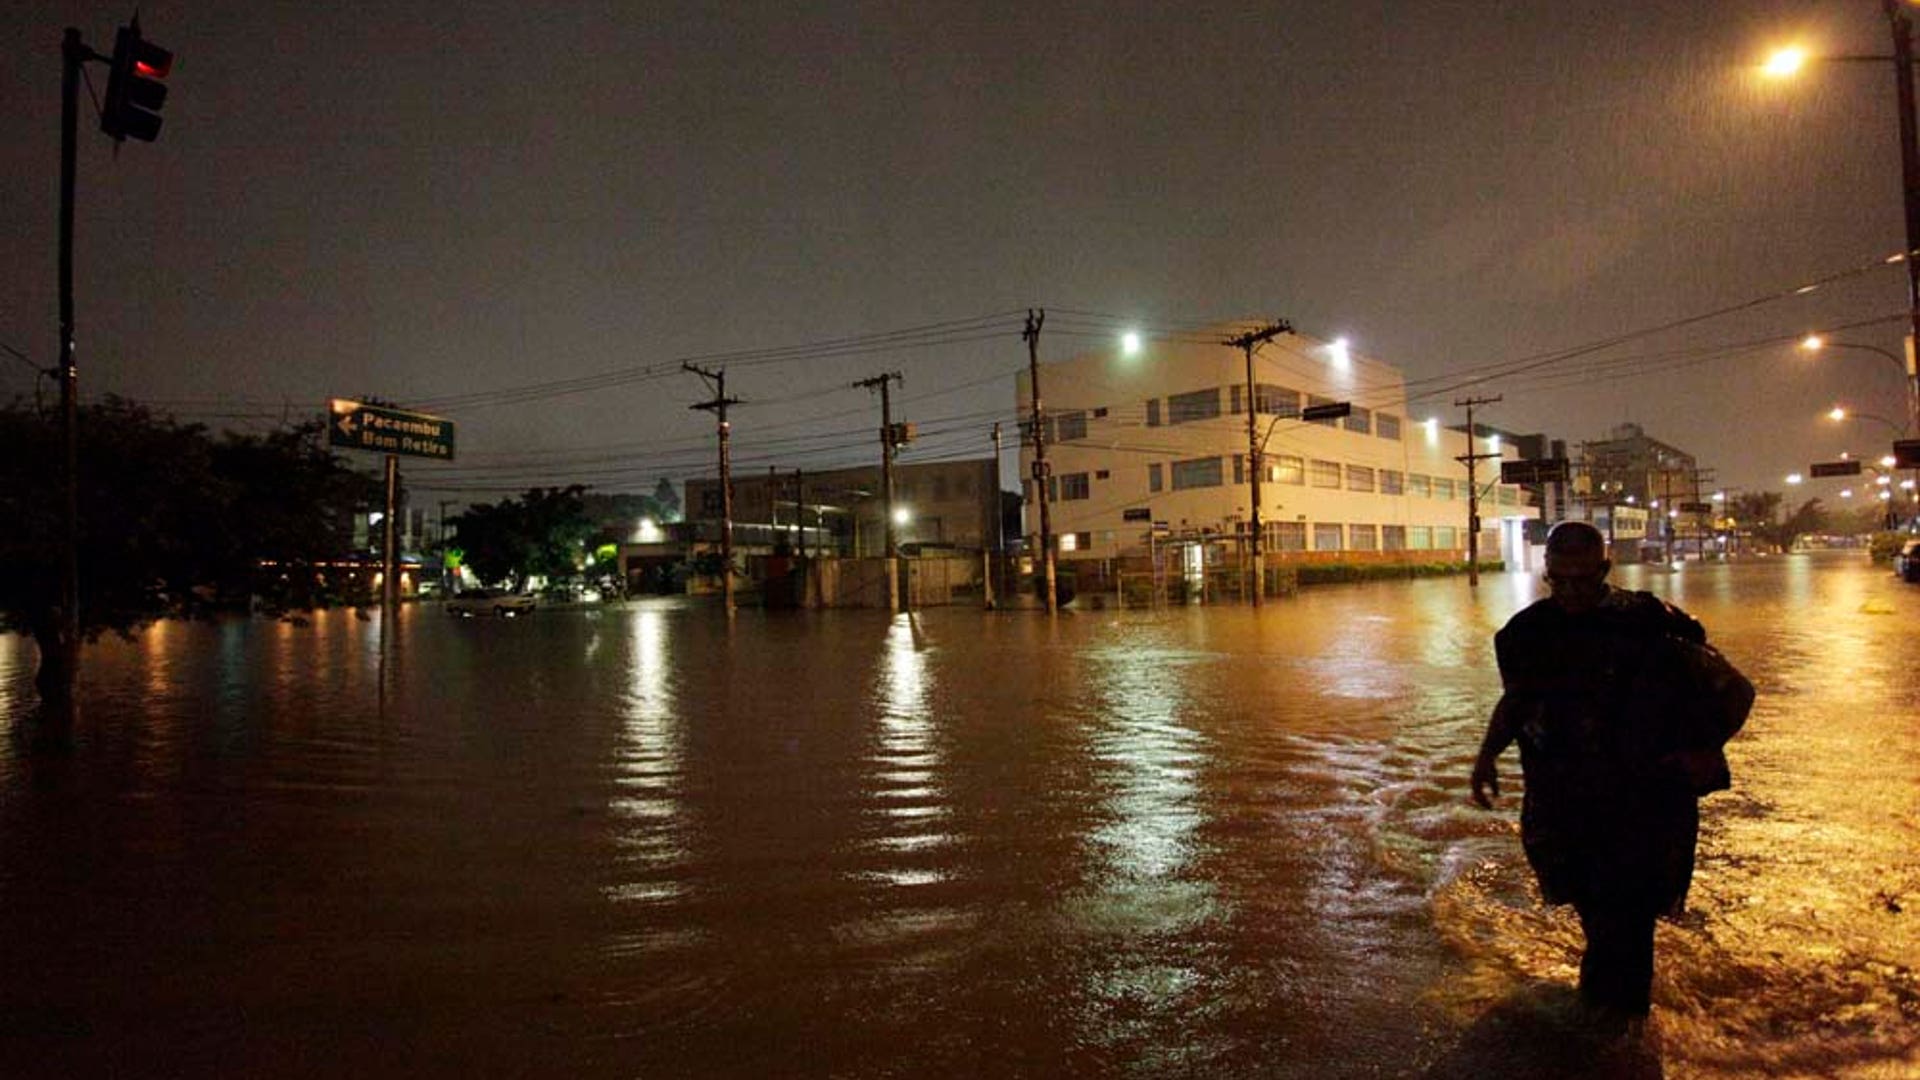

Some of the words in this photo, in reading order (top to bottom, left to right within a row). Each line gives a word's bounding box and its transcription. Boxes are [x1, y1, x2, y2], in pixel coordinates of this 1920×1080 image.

[363, 412, 440, 436] Pacaembu
[363, 431, 397, 447] Bom
[402, 437, 448, 454] Retiro
